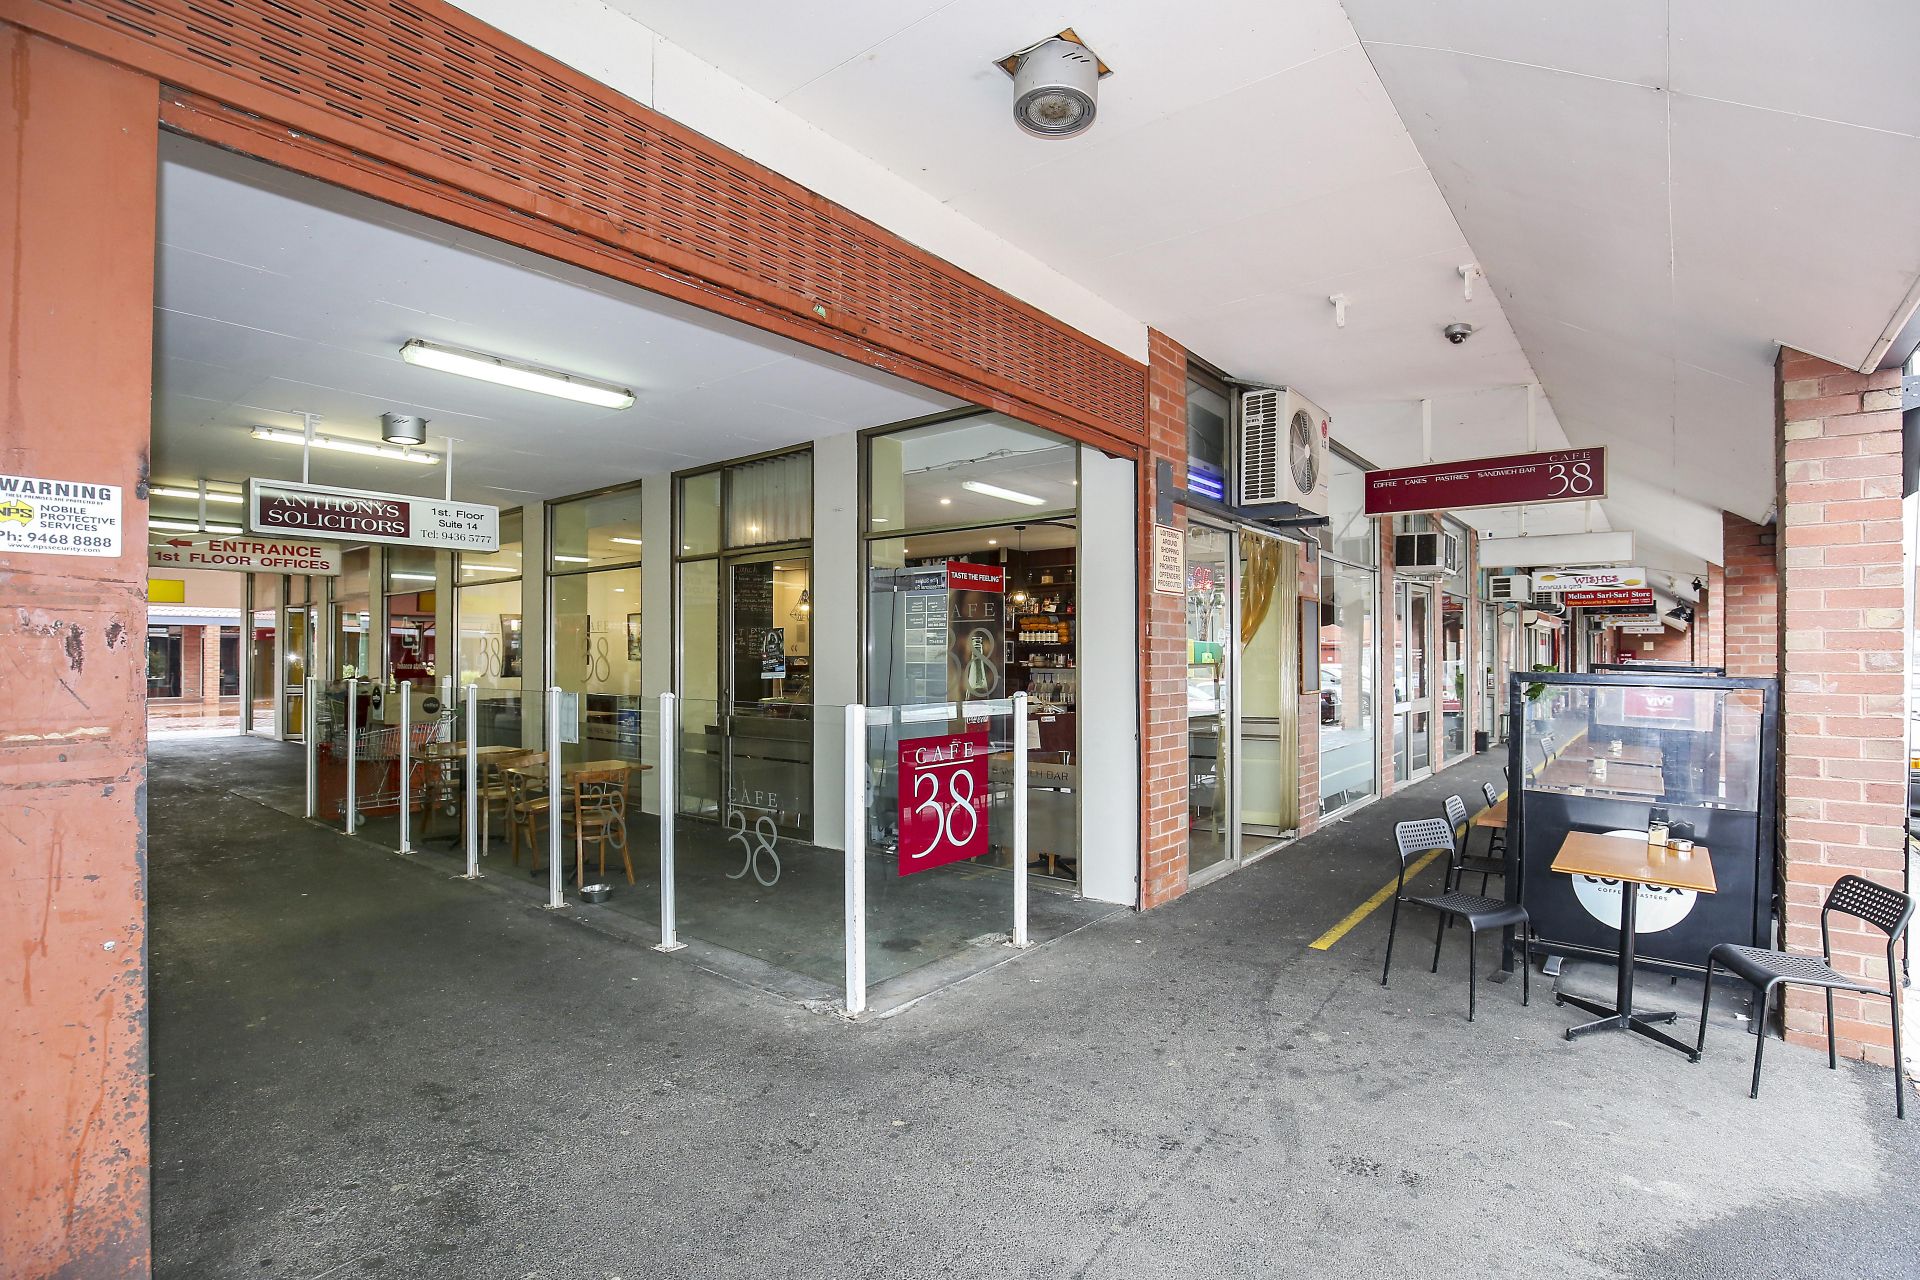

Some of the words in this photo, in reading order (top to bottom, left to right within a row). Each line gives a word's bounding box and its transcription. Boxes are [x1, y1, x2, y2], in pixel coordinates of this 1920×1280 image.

[1549, 451, 1591, 462] CAFE
[1373, 480, 1397, 489] COFFEE
[1404, 478, 1427, 486] CAKES
[1435, 473, 1469, 482] PASTRIES
[1477, 468, 1517, 478] SANDWICH
[1519, 466, 1536, 474] BAR
[1547, 462, 1593, 497] 38
[0, 477, 111, 501] WARNING
[40, 504, 87, 515] NOBILE
[273, 494, 400, 518] ANTHONYS
[40, 512, 116, 526] PROTECTIVE
[431, 508, 451, 518] 1st.
[456, 510, 485, 521] Floor
[40, 521, 98, 532] SERVICES
[267, 510, 405, 534] SOLICITORS
[438, 519, 463, 529] Suite
[466, 522, 478, 531] 14
[0, 530, 22, 542] Ph:
[27, 532, 68, 545] 9468
[73, 535, 112, 548] 8888
[420, 529, 438, 539] Tel:
[441, 531, 466, 542] 9436
[468, 534, 492, 545] 5777
[1162, 538, 1178, 547] AROUND
[8, 543, 101, 553] www.npssecurity.com
[209, 540, 321, 558] ENTRANCE
[1160, 546, 1180, 555] SHOPPING
[154, 552, 180, 562] 1st
[189, 553, 250, 566] FLOOR
[260, 557, 330, 570] OFFICES
[1162, 555, 1178, 563] CENTRE
[1159, 563, 1180, 572] PROHIBITED
[951, 571, 968, 580] TASTE
[968, 573, 979, 581] THE
[979, 574, 1000, 583] FEELING
[1159, 571, 1181, 580] OFFENDERS
[1573, 575, 1619, 584] WISHES
[1157, 579, 1182, 588] PROSECUTED
[1596, 591, 1629, 599] Sari-Sari
[1631, 590, 1651, 598] Store
[479, 636, 501, 678] 38
[915, 741, 974, 764] CAFE
[1046, 770, 1069, 781] BAR
[727, 786, 778, 808] CAFE
[911, 769, 978, 859] 38
[725, 808, 781, 887] 38
